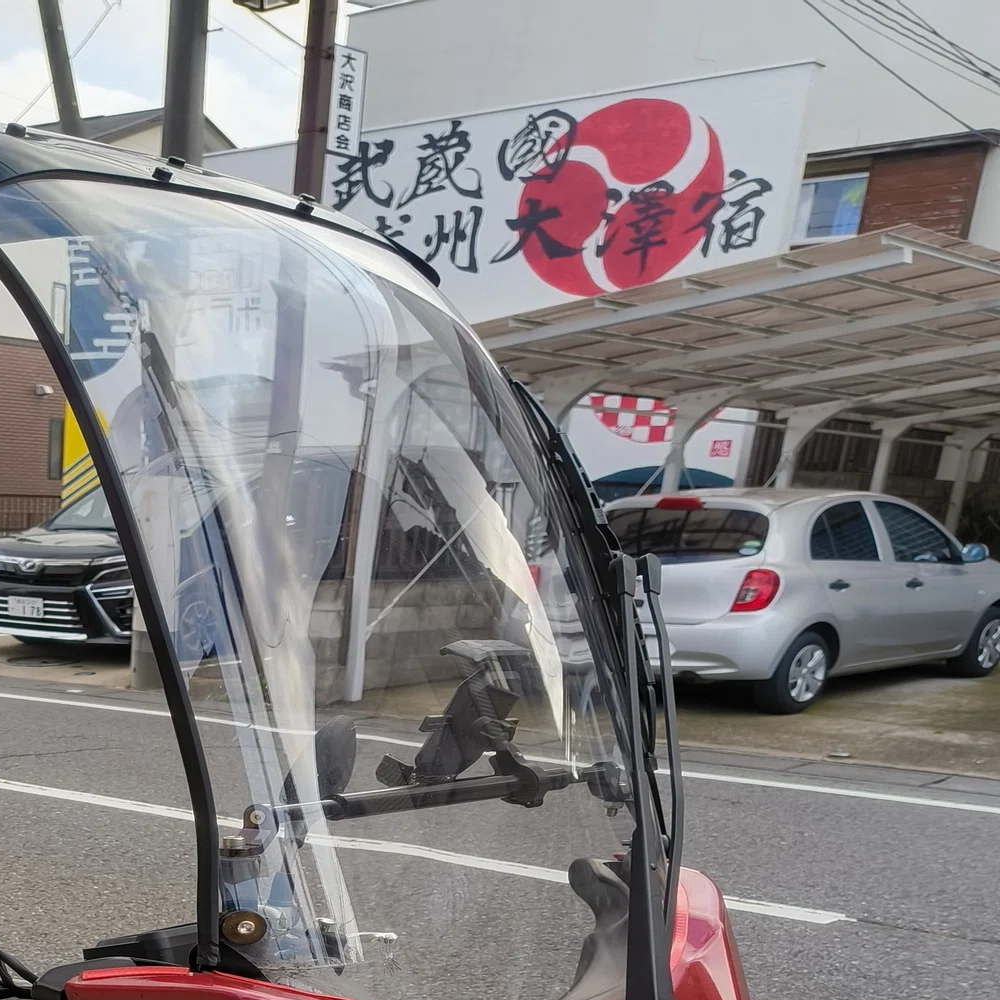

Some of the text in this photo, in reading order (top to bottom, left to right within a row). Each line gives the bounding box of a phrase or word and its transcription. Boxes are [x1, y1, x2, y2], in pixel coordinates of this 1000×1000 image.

[336, 53, 356, 151] 大沢商店会
